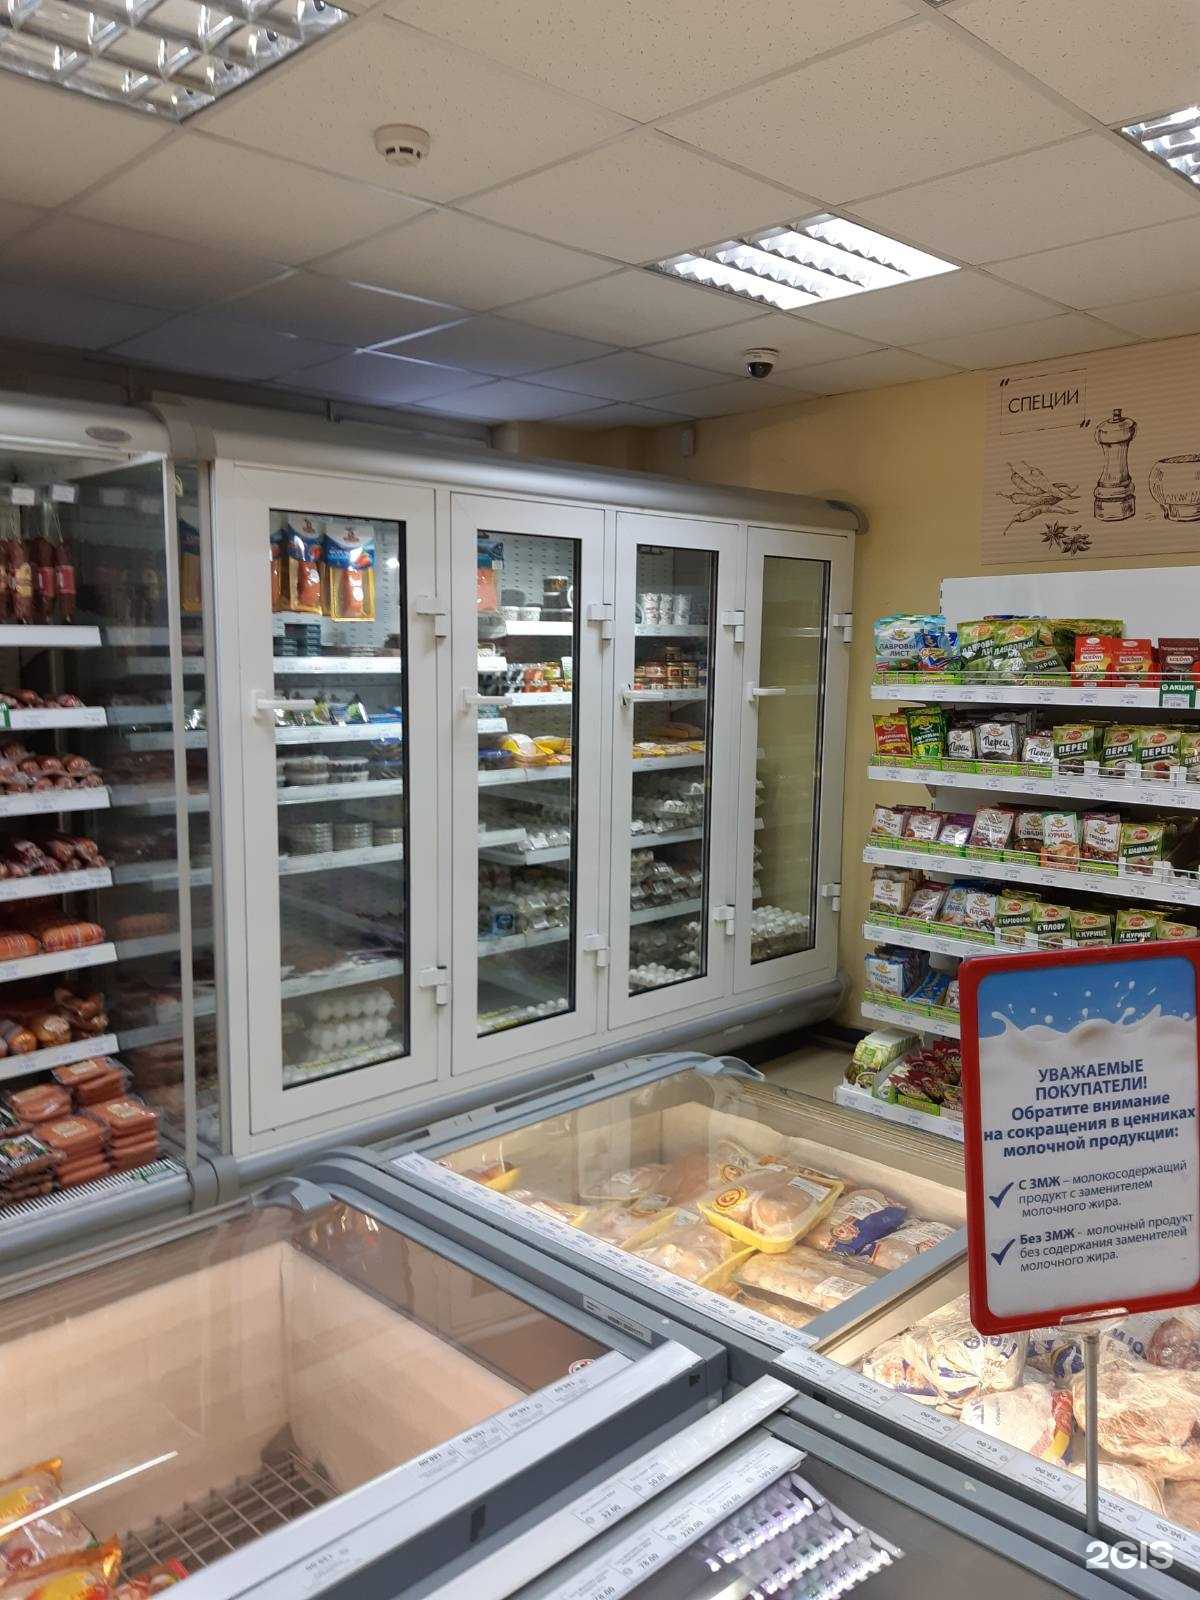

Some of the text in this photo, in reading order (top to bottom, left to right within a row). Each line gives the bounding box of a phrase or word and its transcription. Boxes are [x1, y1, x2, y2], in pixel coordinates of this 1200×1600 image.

[1008, 389, 1079, 413] СПЕЦИИ
[879, 643, 917, 651] ЛАВРОВЫ
[1169, 683, 1194, 692] АКЦИЯ
[983, 736, 1010, 748] Перец
[1058, 742, 1088, 754] ПЕРЕЦ
[1106, 744, 1134, 756] ПЕРЕЦ
[1142, 745, 1174, 757] ПЕРЕЦ
[1043, 923, 1066, 931] ПЛОВУ
[1081, 930, 1107, 938] КУРИЦЕ
[1038, 1059, 1144, 1083] УВАЖАЕМЫЕ
[1036, 1076, 1147, 1101] ПОКУПАТЕЛИ!
[1012, 1093, 1170, 1122] Обратите внимание
[984, 1107, 1196, 1141] на сокращения в ценниках
[1004, 1126, 1179, 1157] молочной продукции:
[1019, 1180, 1027, 1190] С
[1029, 1176, 1060, 1189] ЗМЖ
[1072, 1160, 1187, 1185] молокосодержащий
[1019, 1180, 1153, 1206] продукт с заменителем
[1022, 1197, 1122, 1218] молочного жира.
[1020, 1233, 1042, 1245] Без
[1045, 1228, 1075, 1242] ЗМЖ
[1087, 1219, 1145, 1236] молочный
[1148, 1214, 1194, 1229] продукт
[1020, 1226, 1188, 1259] без содержания заменителей
[1021, 1251, 1119, 1272] молочного жира.
